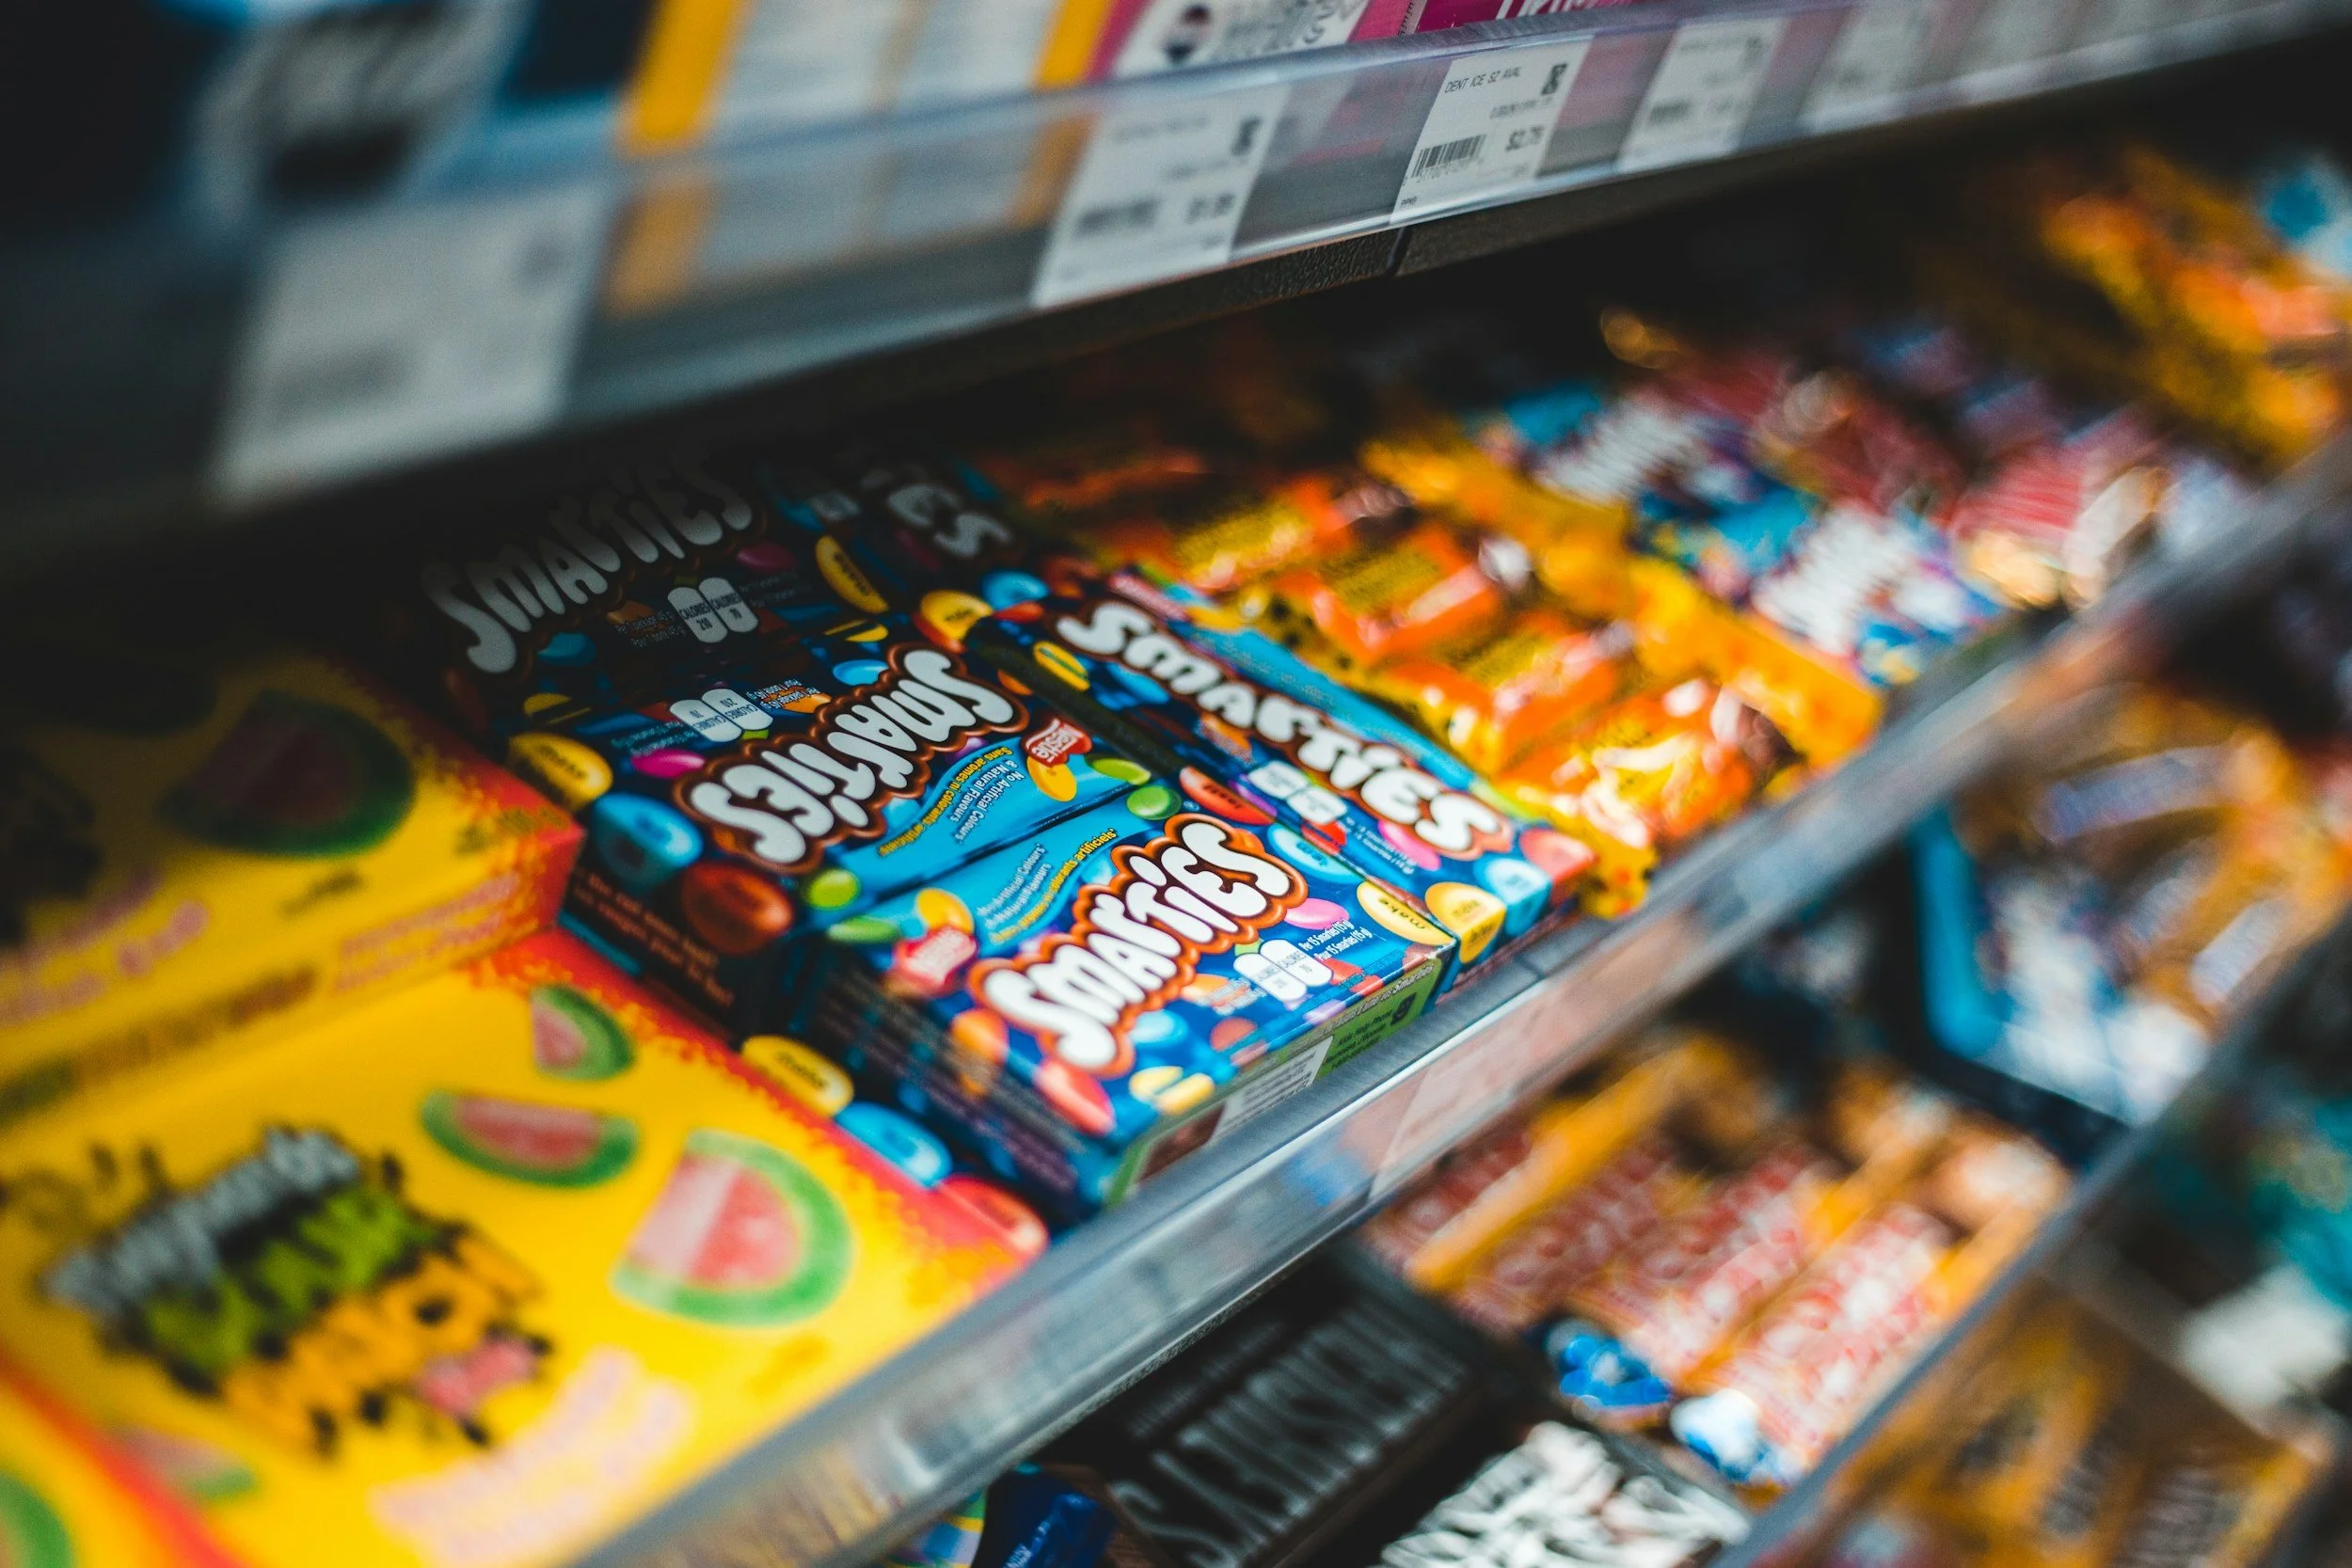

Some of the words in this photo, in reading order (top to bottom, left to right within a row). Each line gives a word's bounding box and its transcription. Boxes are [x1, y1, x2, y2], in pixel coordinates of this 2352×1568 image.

[1470, 73, 1487, 87] ICE
[678, 602, 712, 619] CALORIES
[1057, 600, 1505, 854] SMARTIES
[690, 649, 1014, 863] SMARTIES
[985, 747, 1013, 764] Sans
[979, 764, 1009, 793] Natural
[1007, 771, 1025, 782] No
[922, 789, 956, 826] colorants
[949, 787, 981, 823] Flavours
[981, 777, 1010, 812] Artificial
[1378, 896, 1426, 929] make
[983, 822, 1290, 1069] SMARTIES
[1314, 924, 1341, 945] Smarties
[1336, 933, 1361, 953] Smarties
